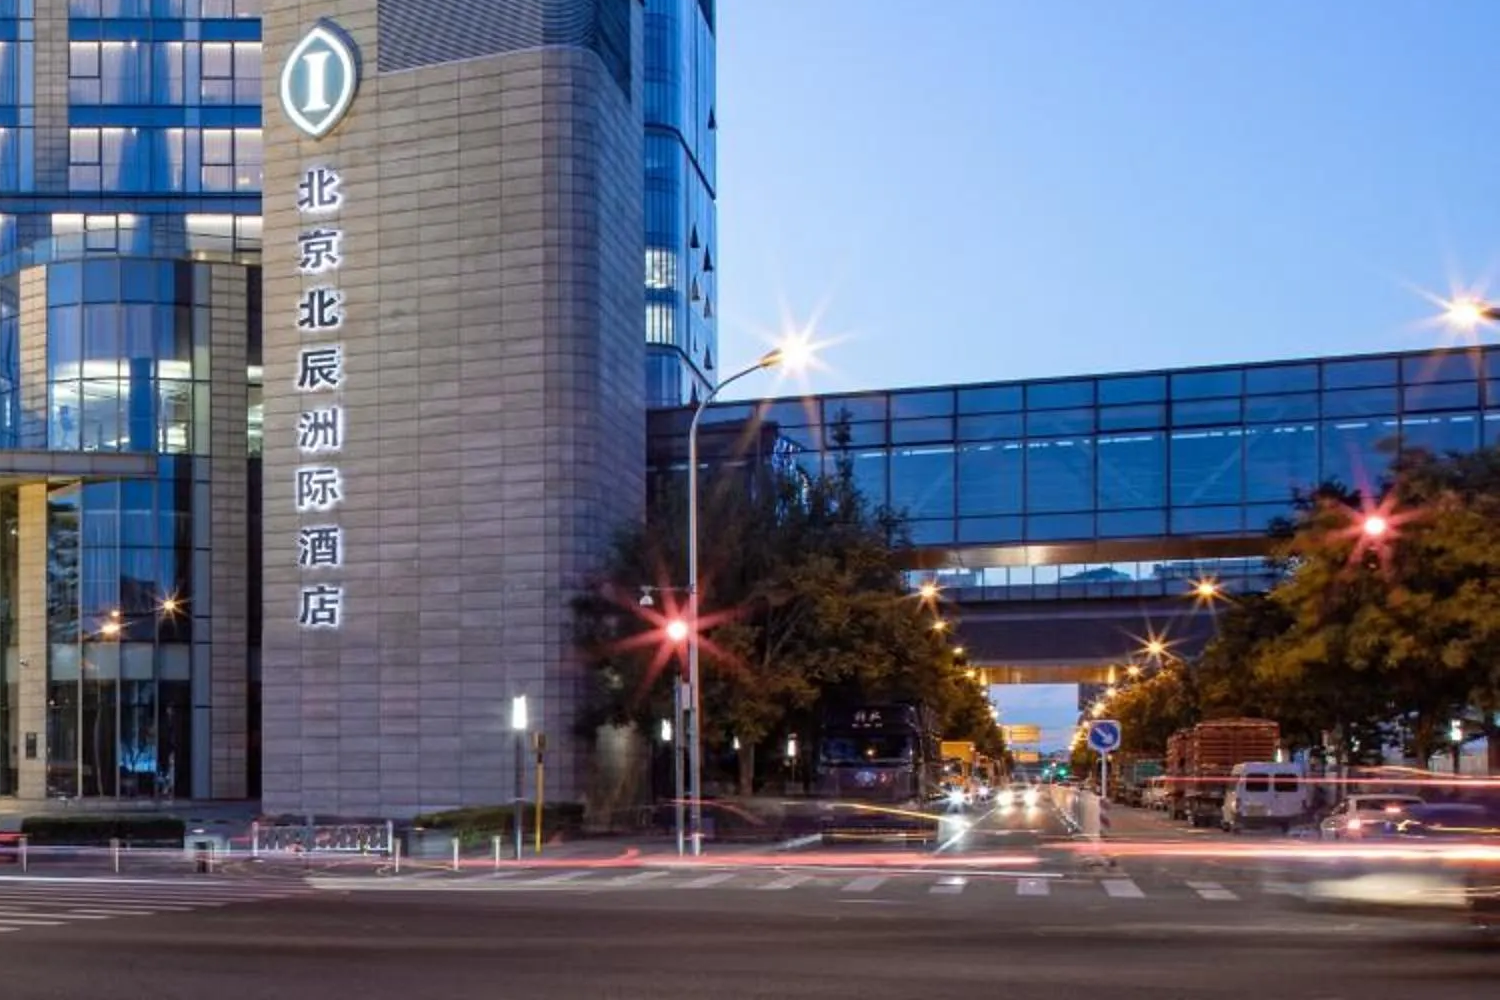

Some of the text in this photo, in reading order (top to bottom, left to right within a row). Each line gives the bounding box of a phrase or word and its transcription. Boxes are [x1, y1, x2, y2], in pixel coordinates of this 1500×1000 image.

[296, 169, 340, 626] 北京北辰洲际酒店
